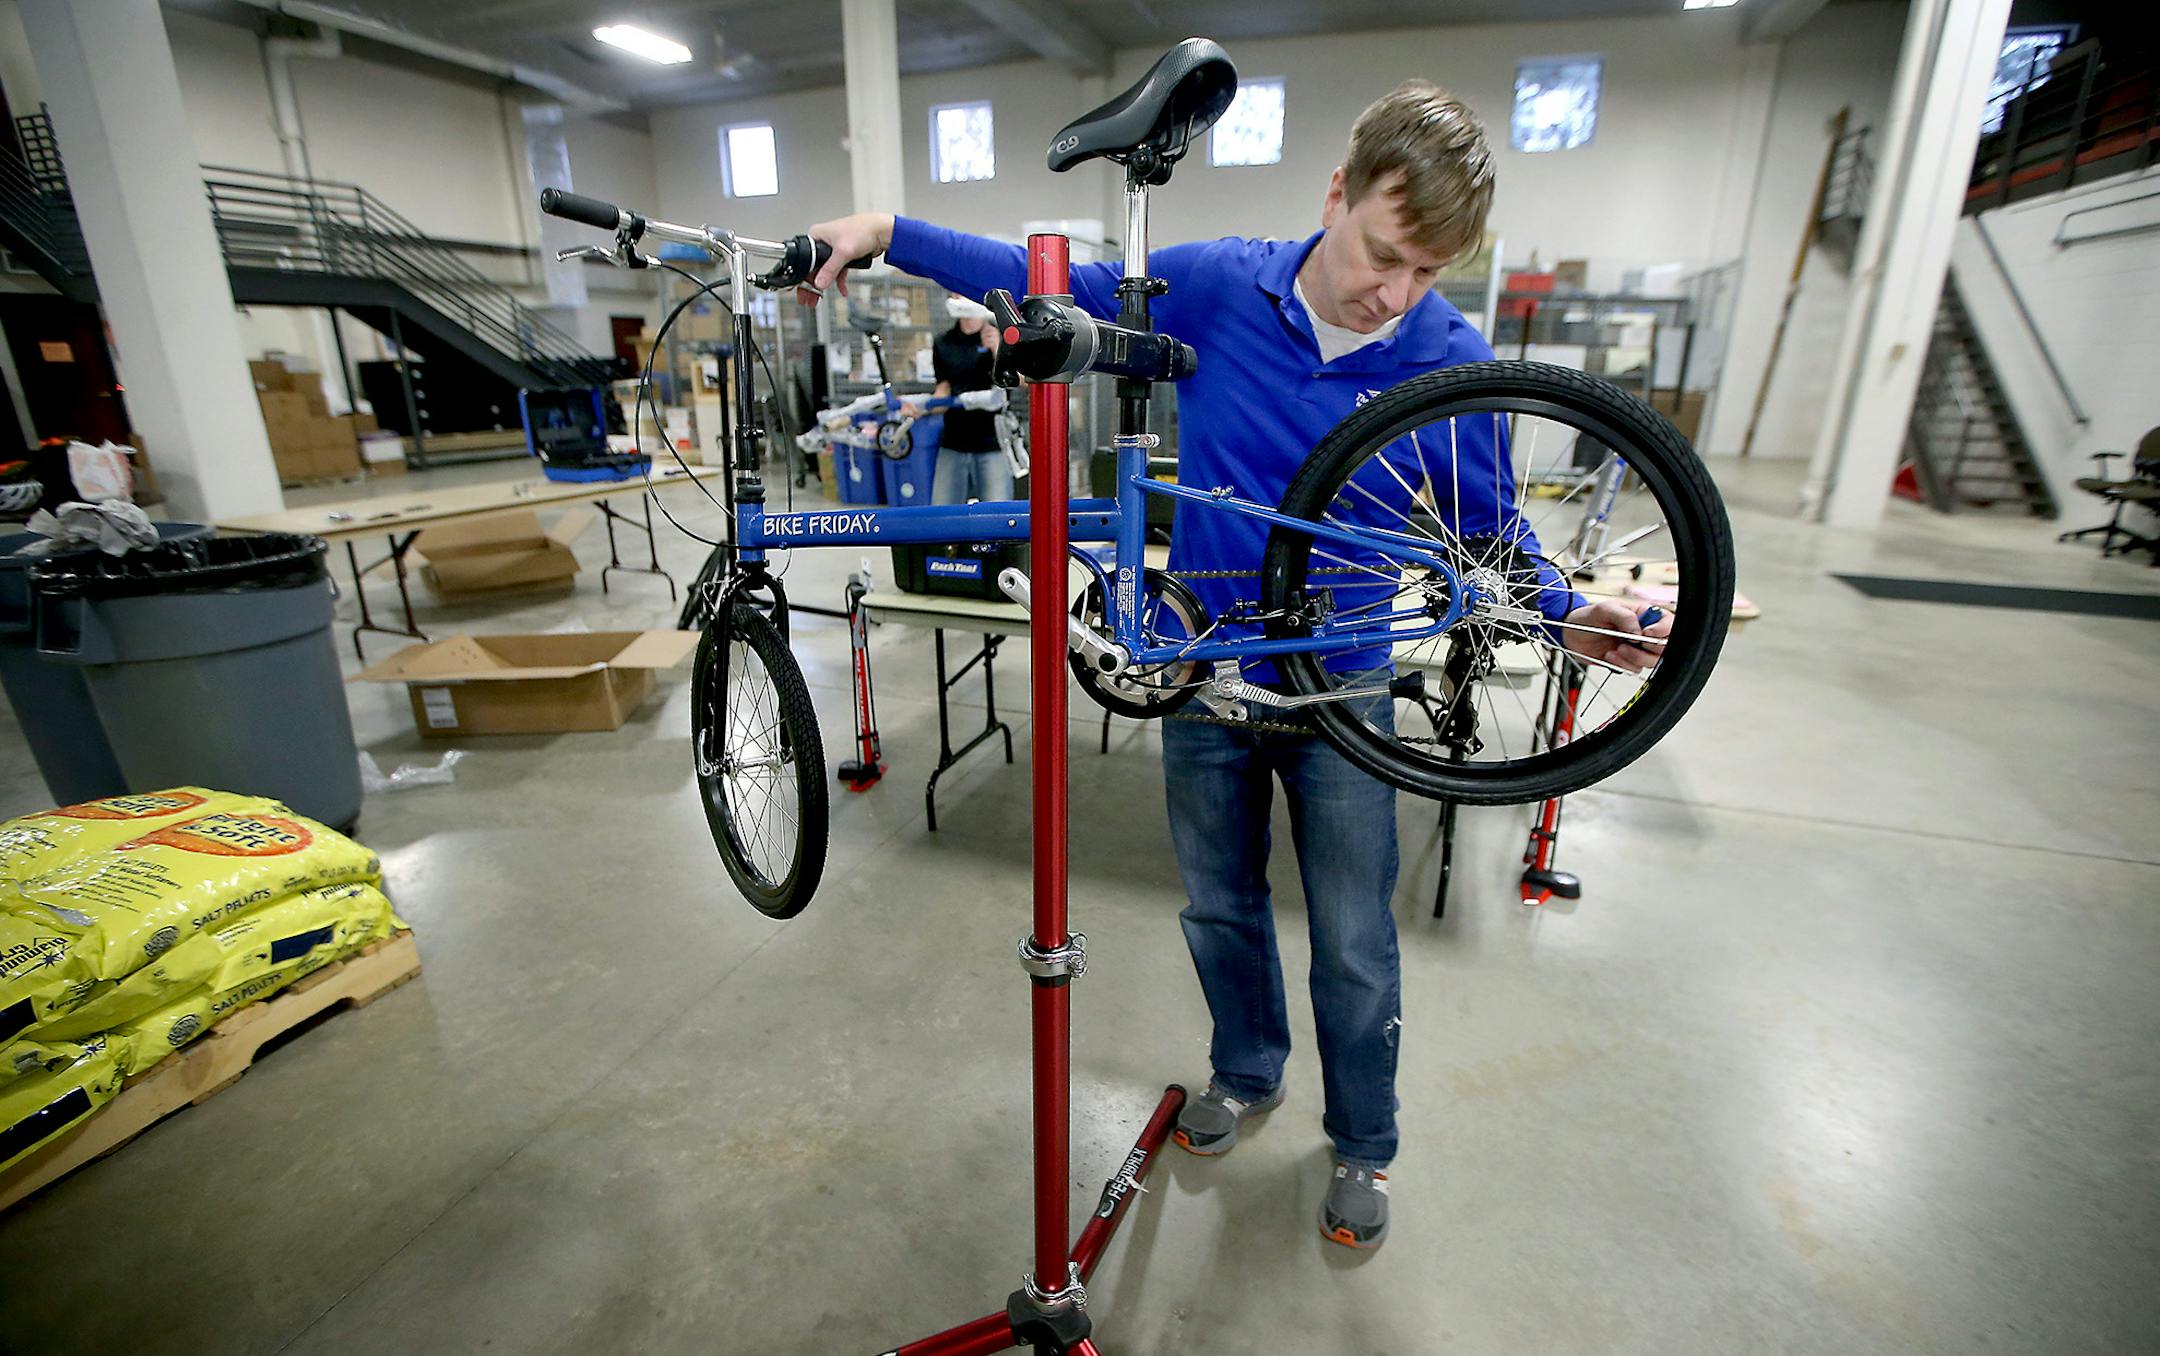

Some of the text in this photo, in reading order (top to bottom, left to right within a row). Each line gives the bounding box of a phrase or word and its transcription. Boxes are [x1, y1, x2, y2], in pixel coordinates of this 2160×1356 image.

[763, 517, 804, 536] BIKE
[201, 825, 266, 848] Soft
[192, 907, 222, 931] SALT
[212, 973, 283, 1015] SALT PELLETS
[1107, 1147, 1148, 1201] FEEDBACK
